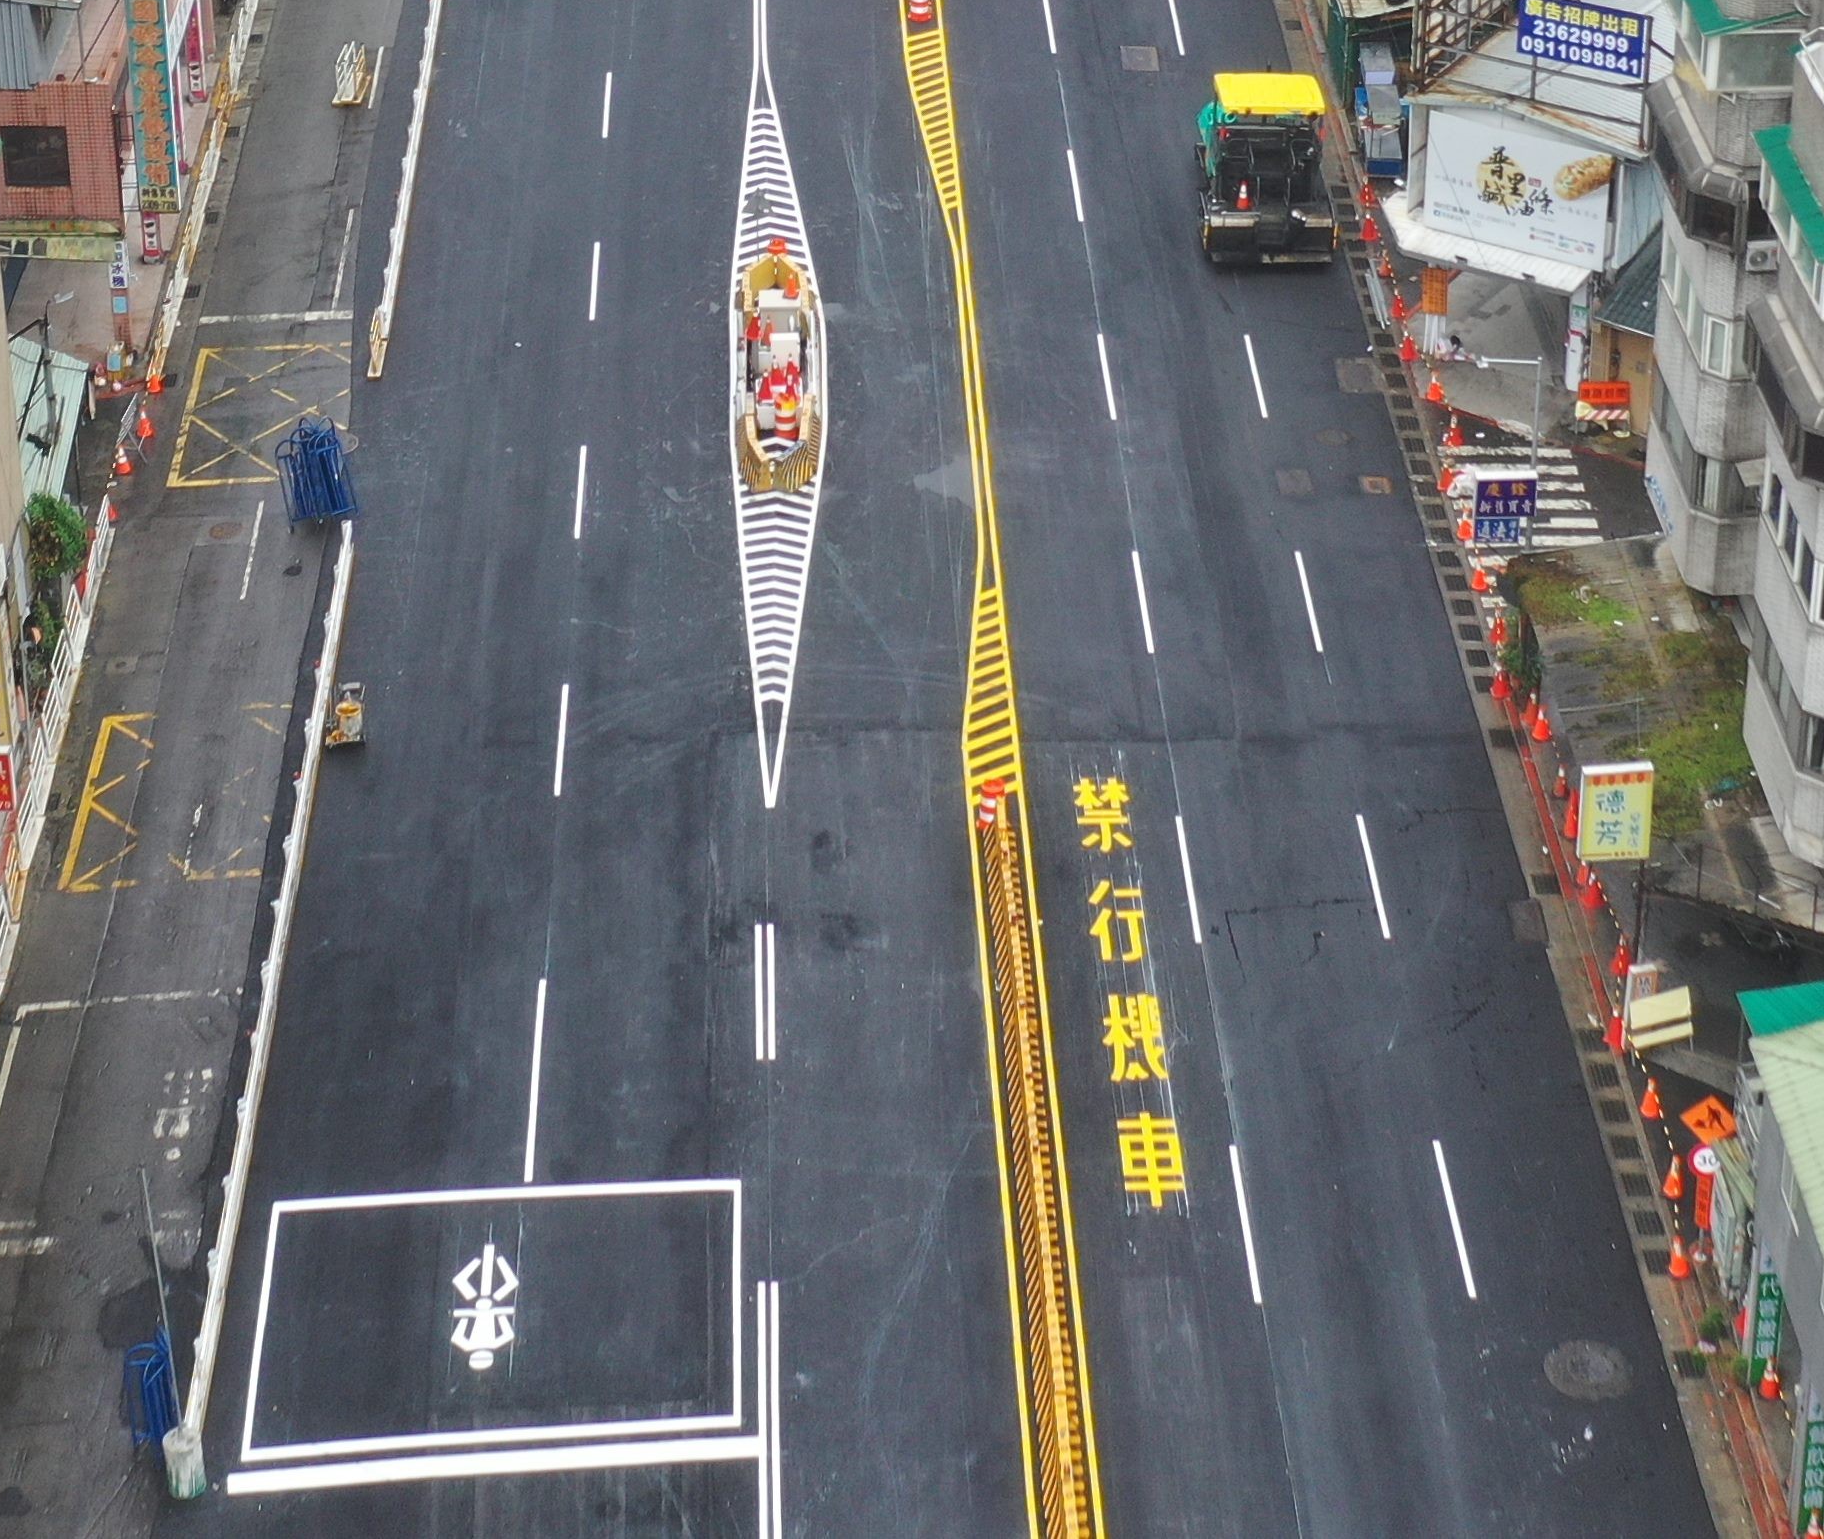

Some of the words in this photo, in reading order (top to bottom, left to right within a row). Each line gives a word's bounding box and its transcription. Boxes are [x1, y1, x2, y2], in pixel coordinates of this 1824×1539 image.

[1521, 35, 1639, 75] 0911098841
[1533, 19, 1629, 54] 23629999
[1073, 776, 1185, 1208] 禁行機車
